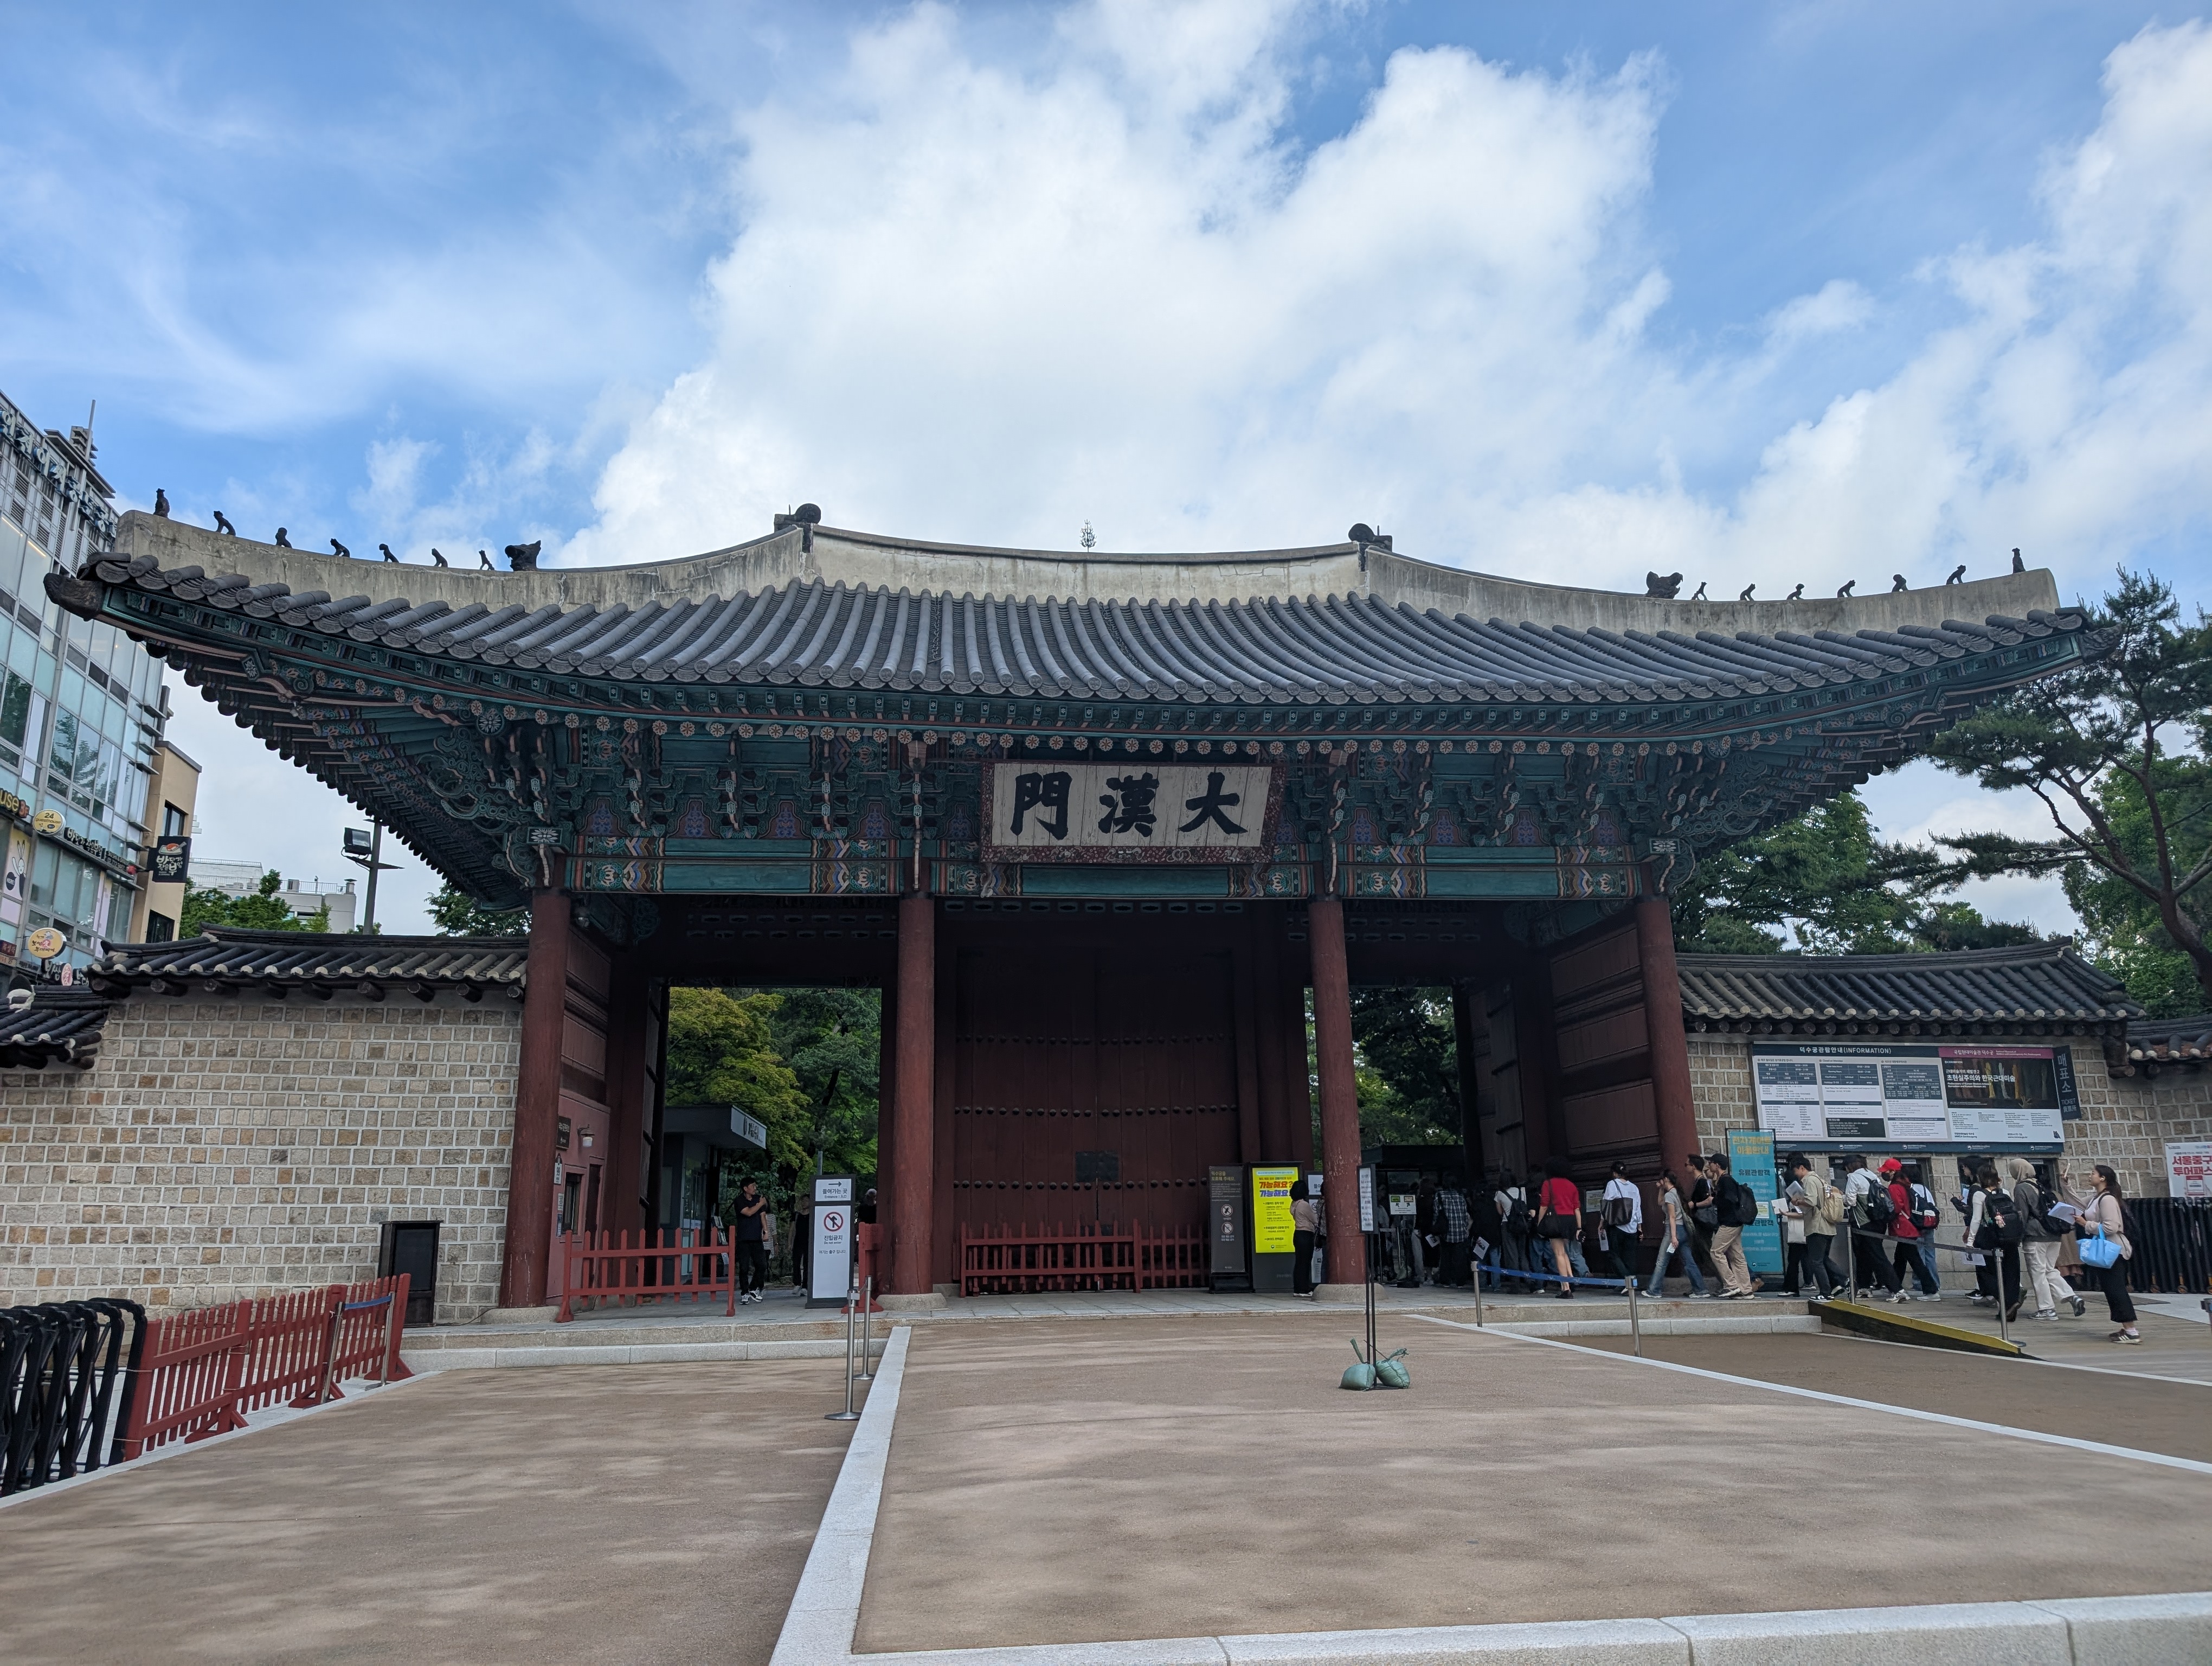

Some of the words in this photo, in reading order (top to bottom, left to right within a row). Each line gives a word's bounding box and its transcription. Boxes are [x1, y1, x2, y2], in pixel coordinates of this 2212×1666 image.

[2057, 1053, 2072, 1093] 매표소
[2061, 1098, 2076, 1106] TICKET
[2172, 1156, 2212, 1165] 서울중구
[2174, 1167, 2212, 1176] 투어패스
